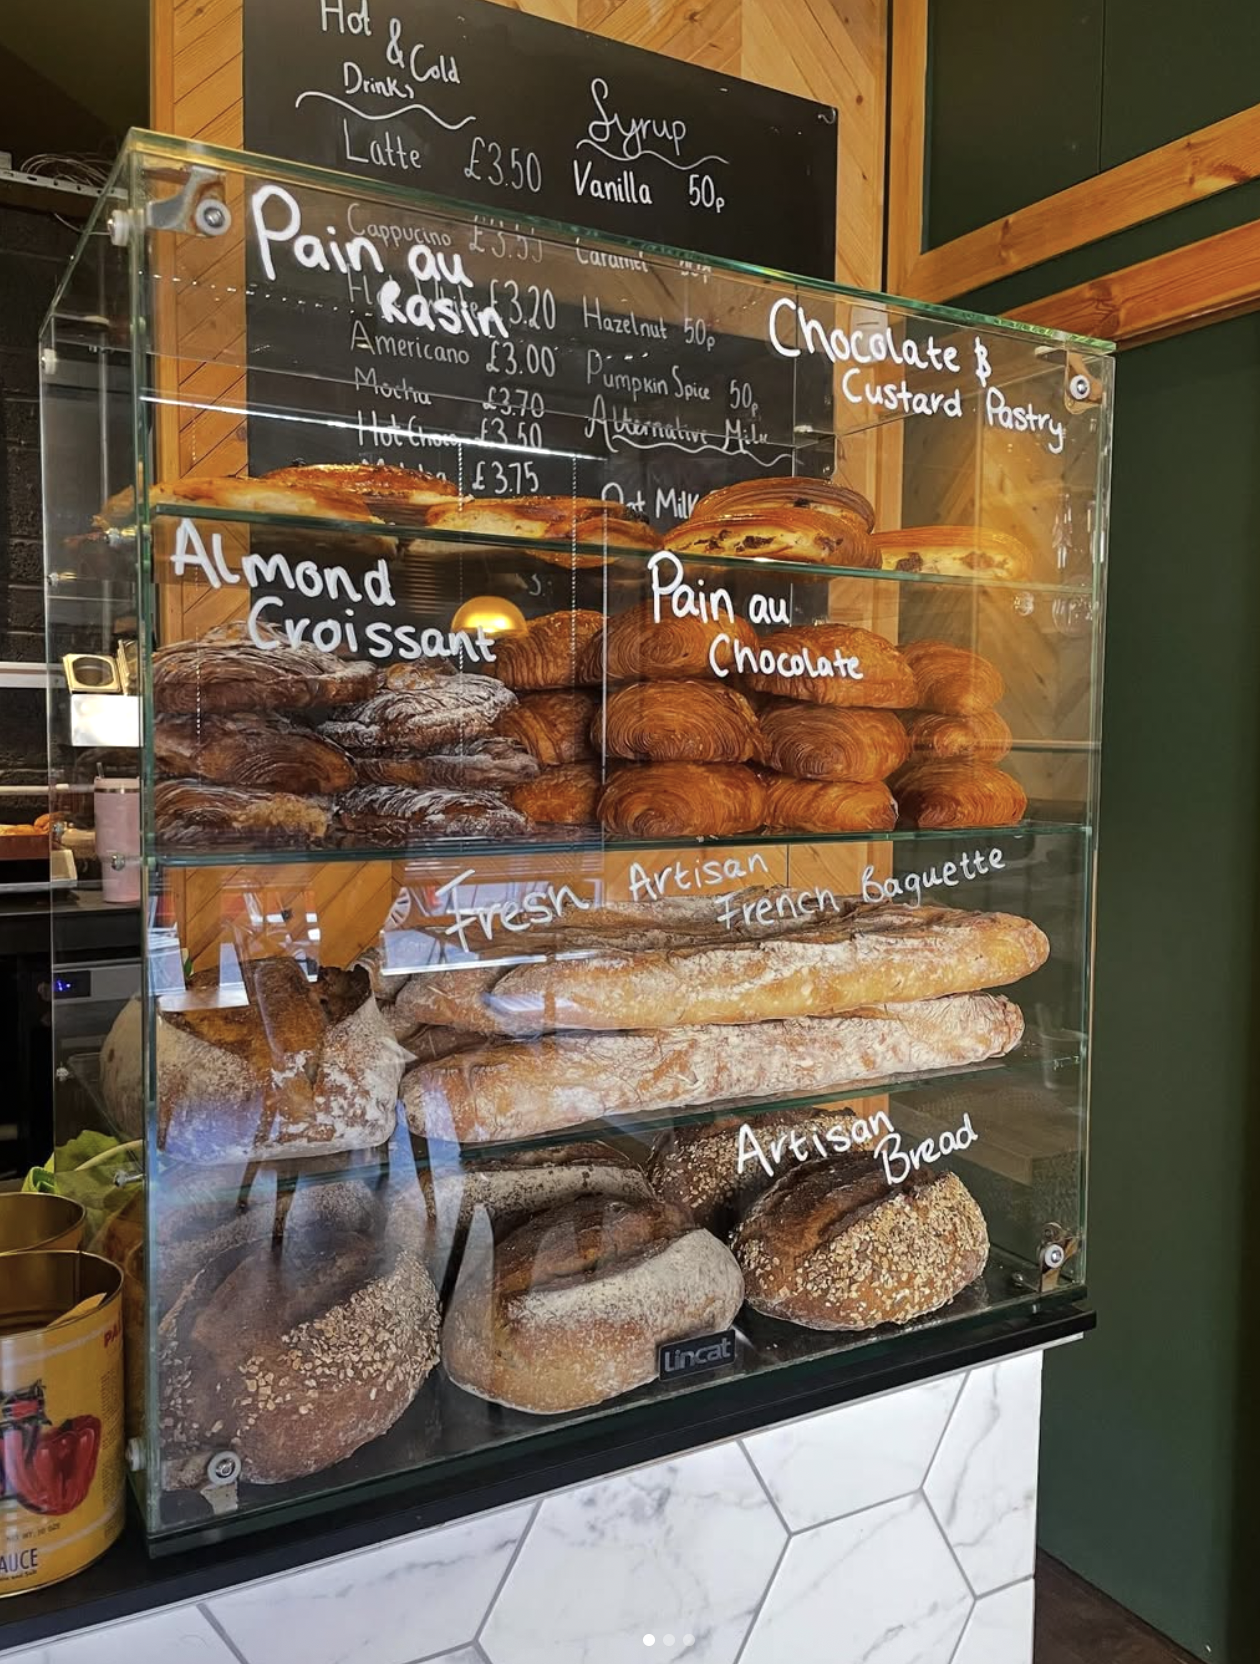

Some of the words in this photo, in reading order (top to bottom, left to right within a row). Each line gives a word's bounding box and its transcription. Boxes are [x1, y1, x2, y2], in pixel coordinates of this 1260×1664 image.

[321, 0, 372, 36] Hot
[386, 18, 405, 69] &
[410, 44, 460, 84] Cold
[344, 62, 414, 99] Drinks
[588, 78, 686, 159] Syrup
[343, 118, 422, 169] Latte
[464, 137, 542, 192] £3.50
[573, 160, 653, 205] Vanilla
[689, 174, 725, 213] 50p
[252, 185, 384, 281] Pain
[408, 244, 474, 288] au
[347, 203, 451, 248] Cappucino
[488, 279, 556, 330] £3.20
[582, 295, 668, 340] Hazelnut
[684, 317, 716, 351] 50p
[351, 320, 470, 365] Americano
[486, 340, 556, 378] £3.00
[769, 298, 961, 373] Chocolate
[482, 386, 545, 418] £3.70
[587, 349, 669, 402] Pumpkin
[671, 365, 711, 401] Spice
[730, 379, 759, 418] 50p
[842, 368, 963, 418] Custard
[986, 386, 1066, 455] Pastry
[475, 418, 543, 449] £350
[472, 461, 539, 494] £3.75
[170, 518, 396, 607] Almond
[647, 550, 735, 624] Pain
[749, 594, 791, 624] au
[247, 595, 498, 663] Croissant
[708, 633, 864, 679] Chocolate
[629, 850, 769, 902] Artisan
[737, 1110, 895, 1178] Artisan
[873, 1112, 979, 1185] Bread
[664, 1337, 731, 1372] Lincat
